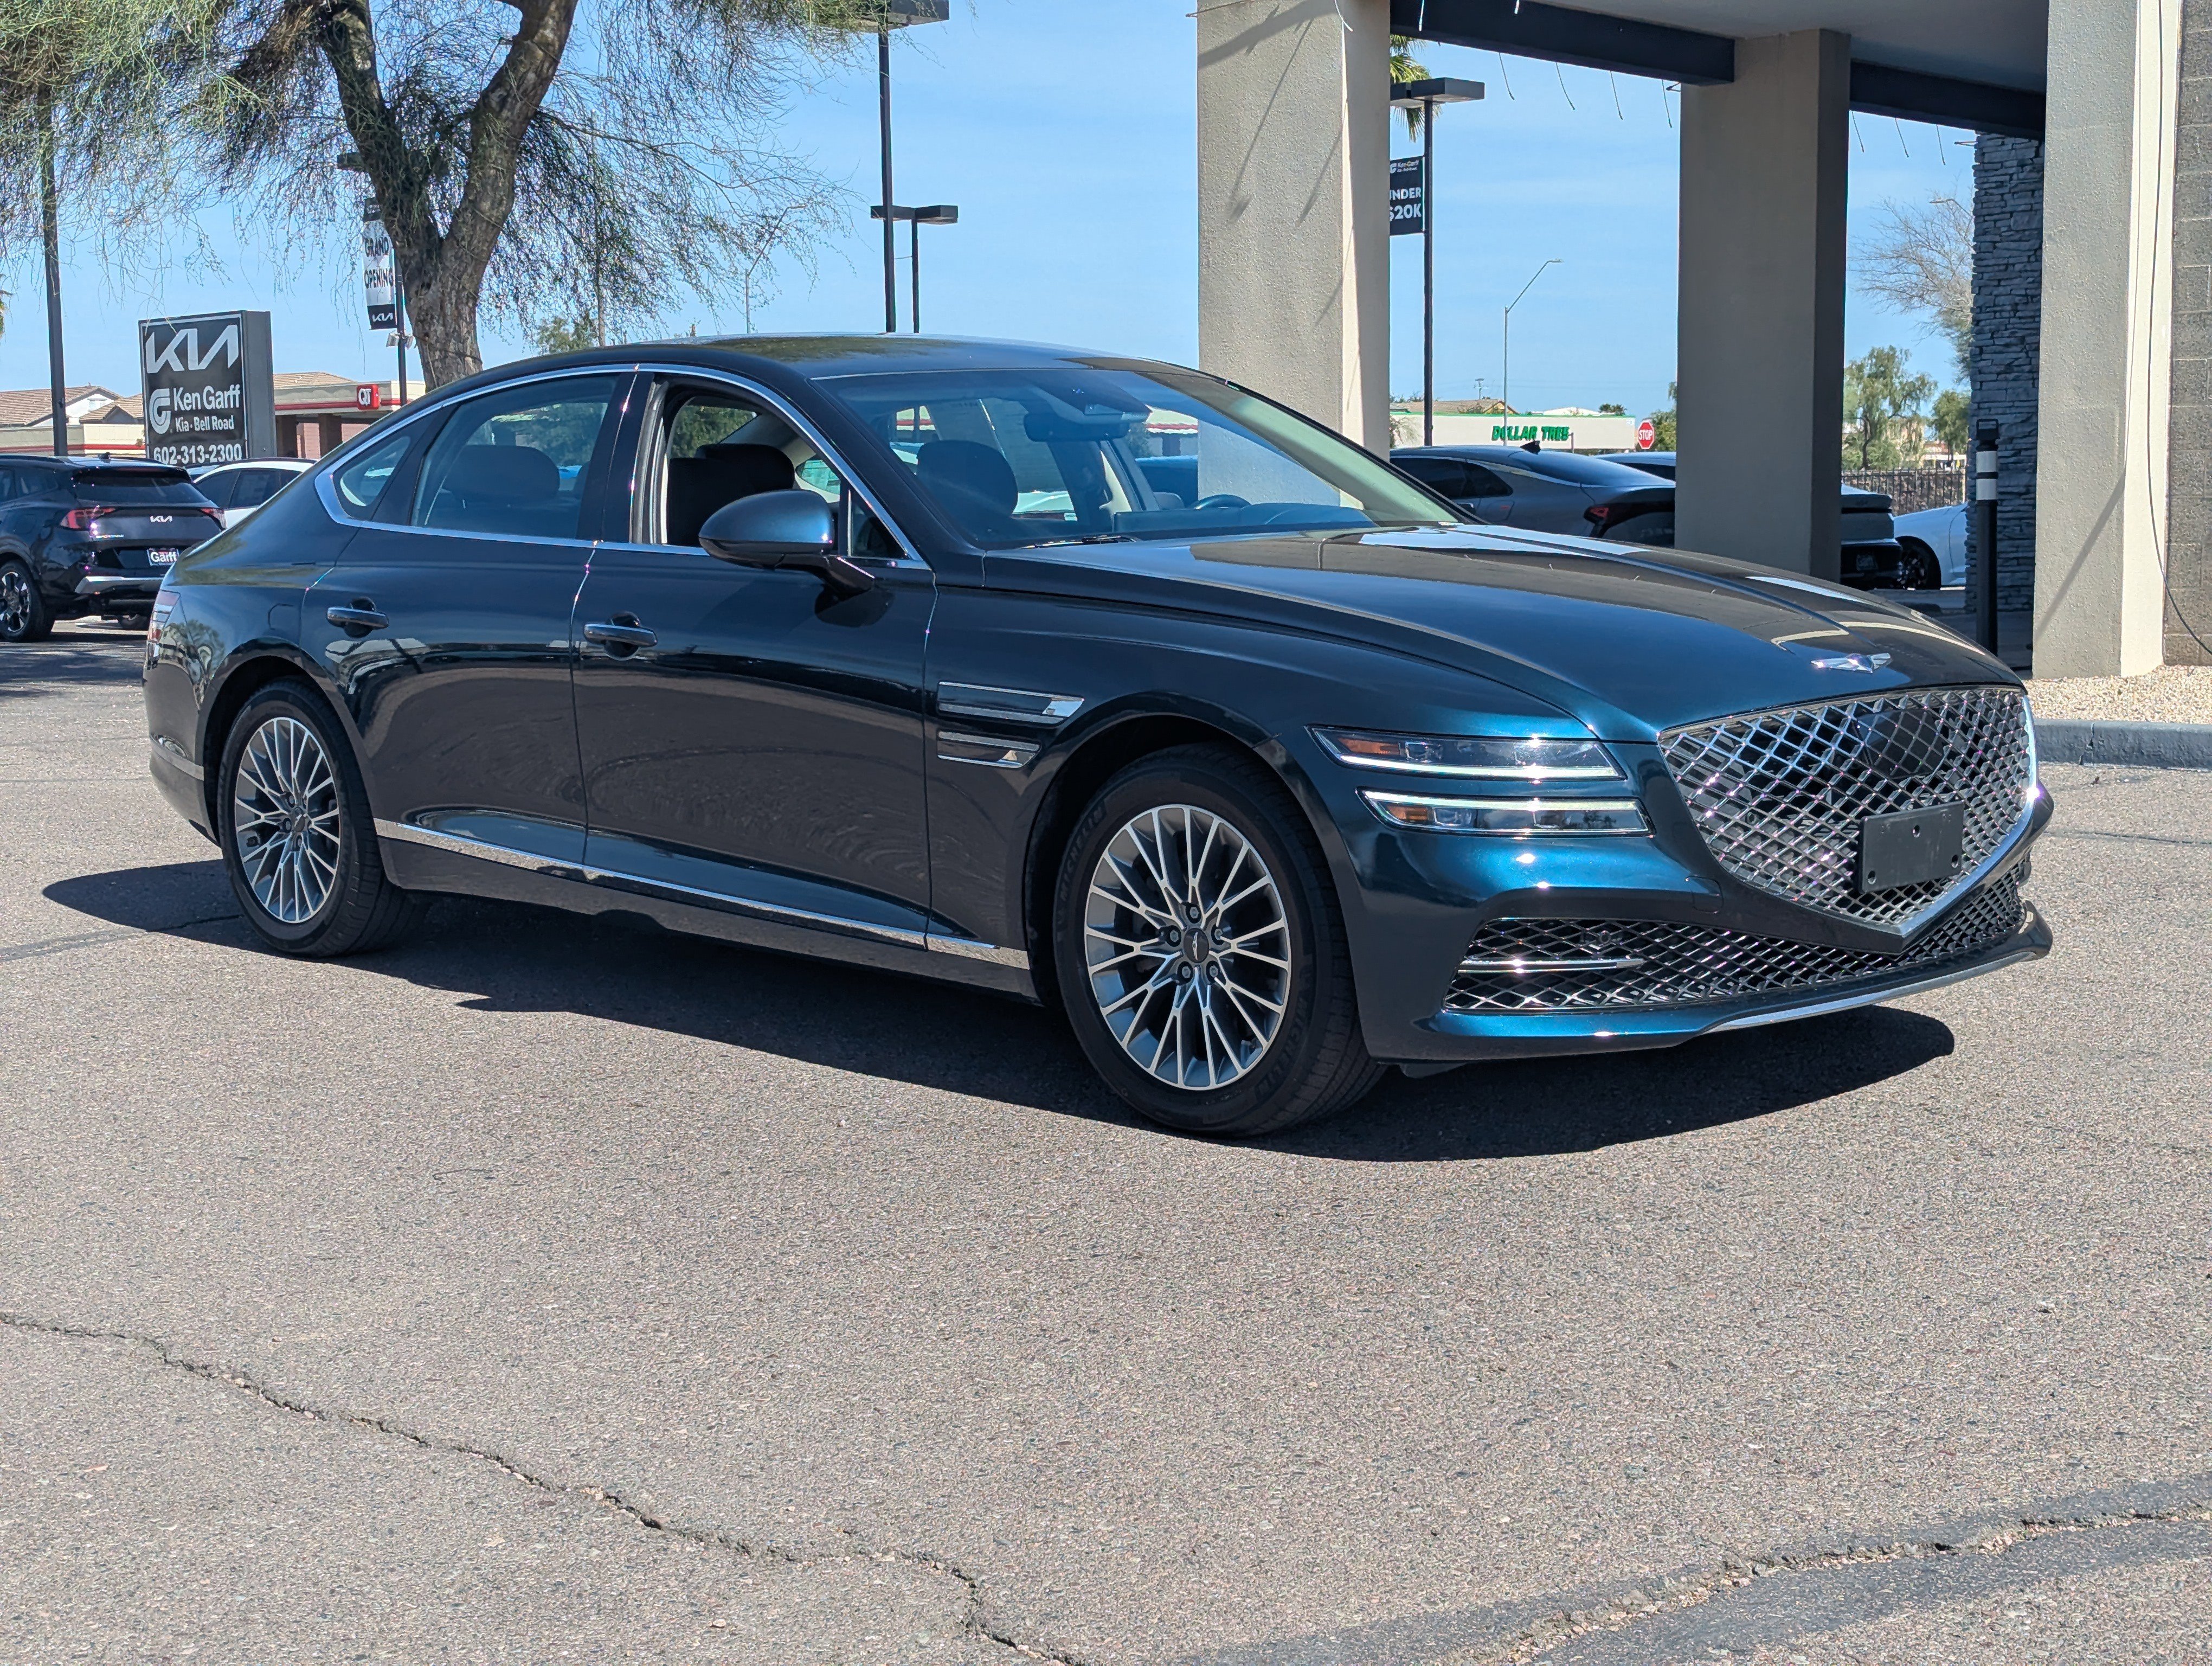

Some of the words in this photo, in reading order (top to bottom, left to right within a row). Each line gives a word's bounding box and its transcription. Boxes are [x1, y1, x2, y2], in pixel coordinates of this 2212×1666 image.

[364, 236, 389, 257] GRAND
[364, 267, 394, 289] OPENING
[372, 312, 393, 322] KIA
[145, 324, 239, 374] KIA
[173, 387, 201, 411] Ken
[203, 384, 240, 410] Garff
[358, 388, 371, 406] QT
[175, 416, 189, 432] Kia
[193, 415, 210, 431] Bell
[211, 414, 234, 430] Road
[1638, 430, 1653, 440] STOP
[153, 443, 242, 465] 602-313-2300
[150, 552, 177, 562] Garff
